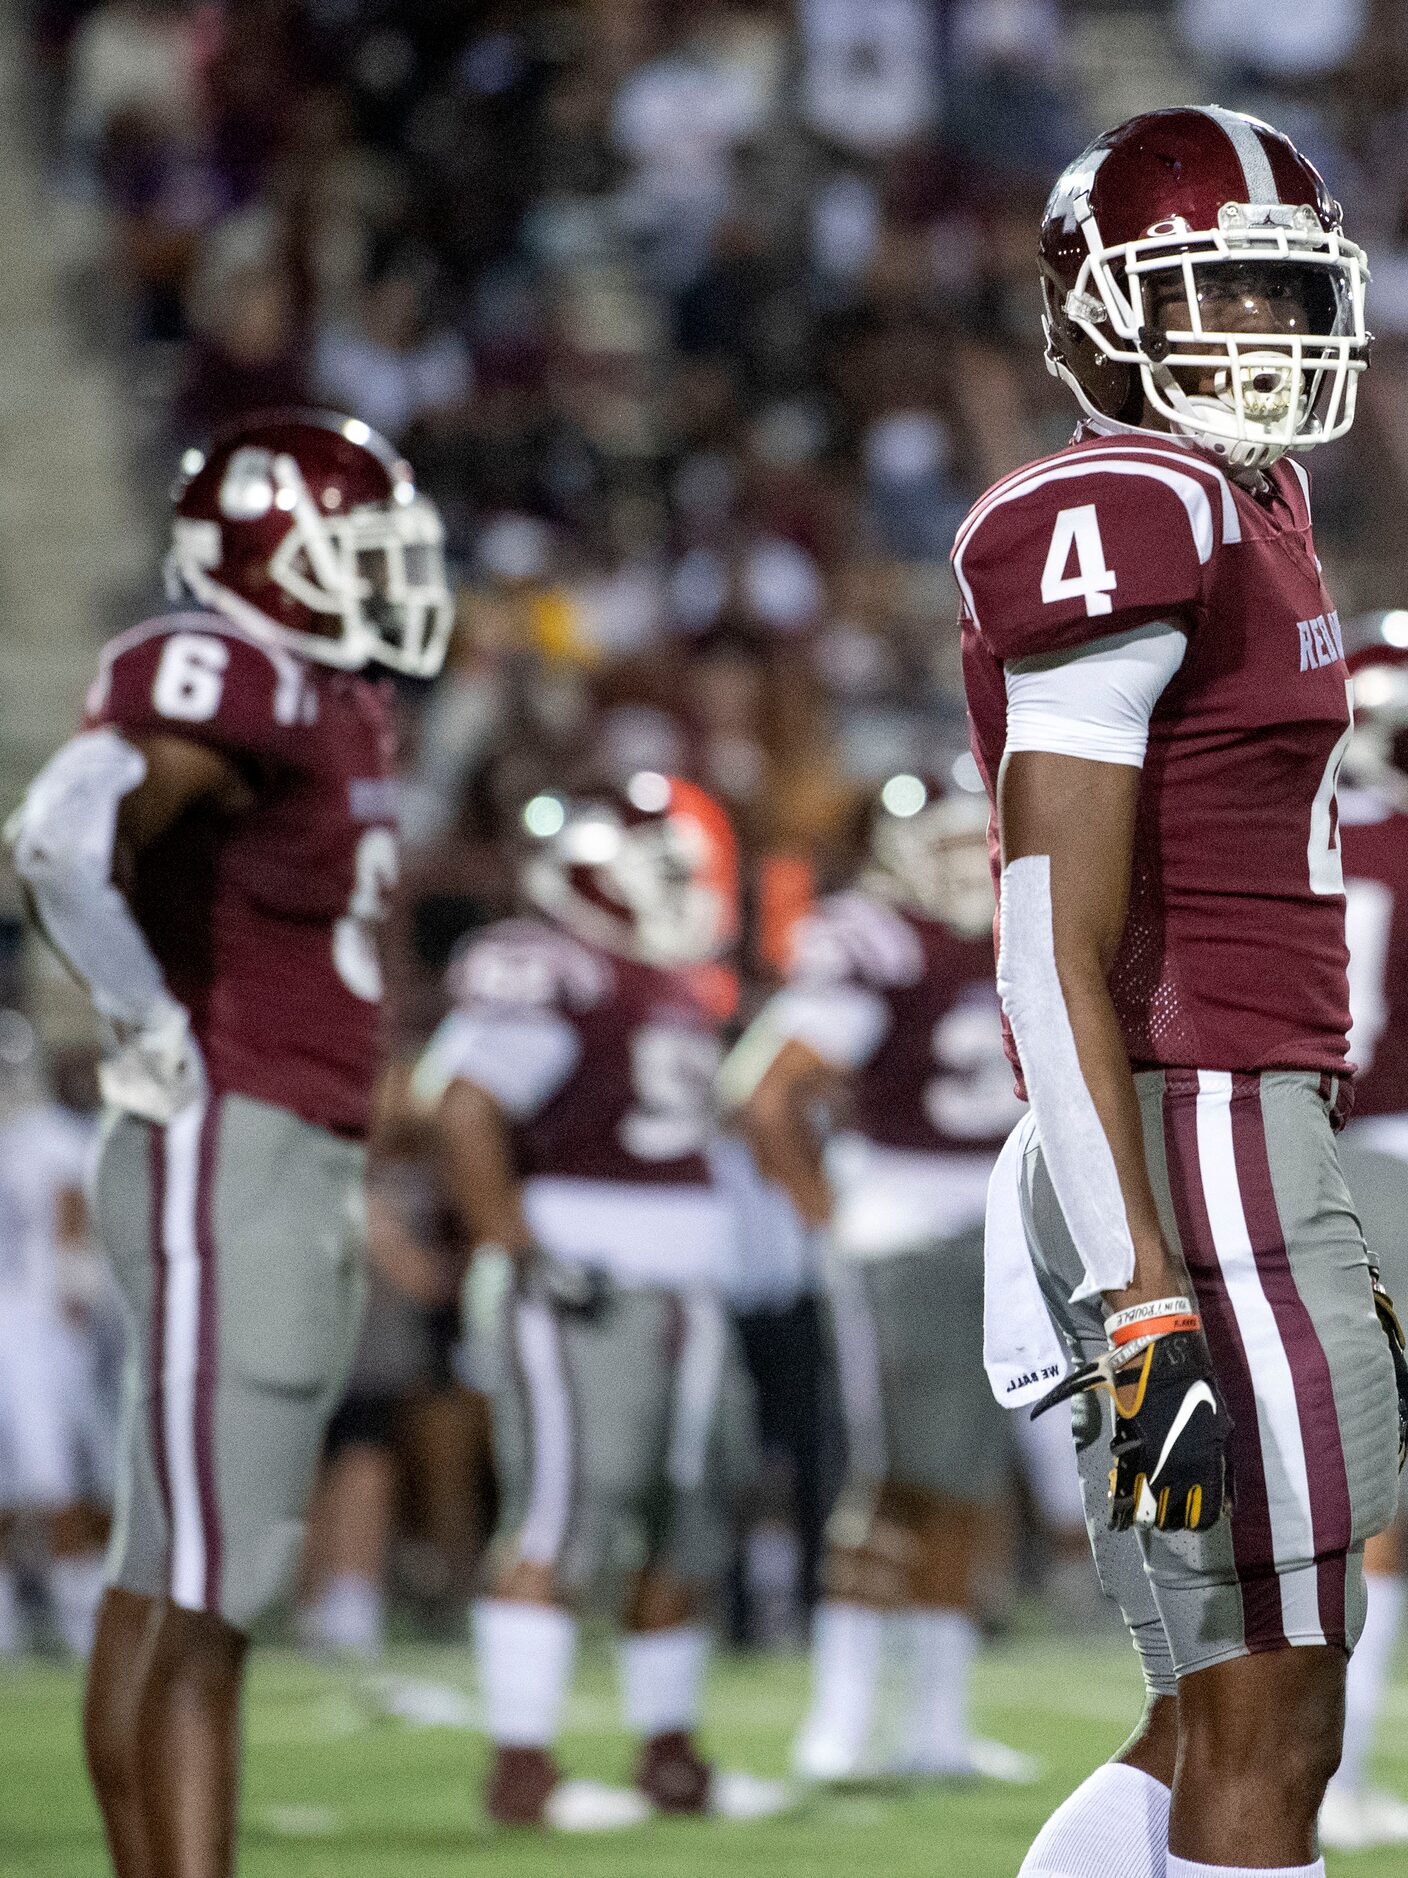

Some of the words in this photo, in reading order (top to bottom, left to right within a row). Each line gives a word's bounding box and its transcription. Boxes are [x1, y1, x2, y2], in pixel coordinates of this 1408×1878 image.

[1040, 503, 1117, 617] 4
[152, 632, 230, 724] 6
[1041, 1364, 1060, 1380] WE
